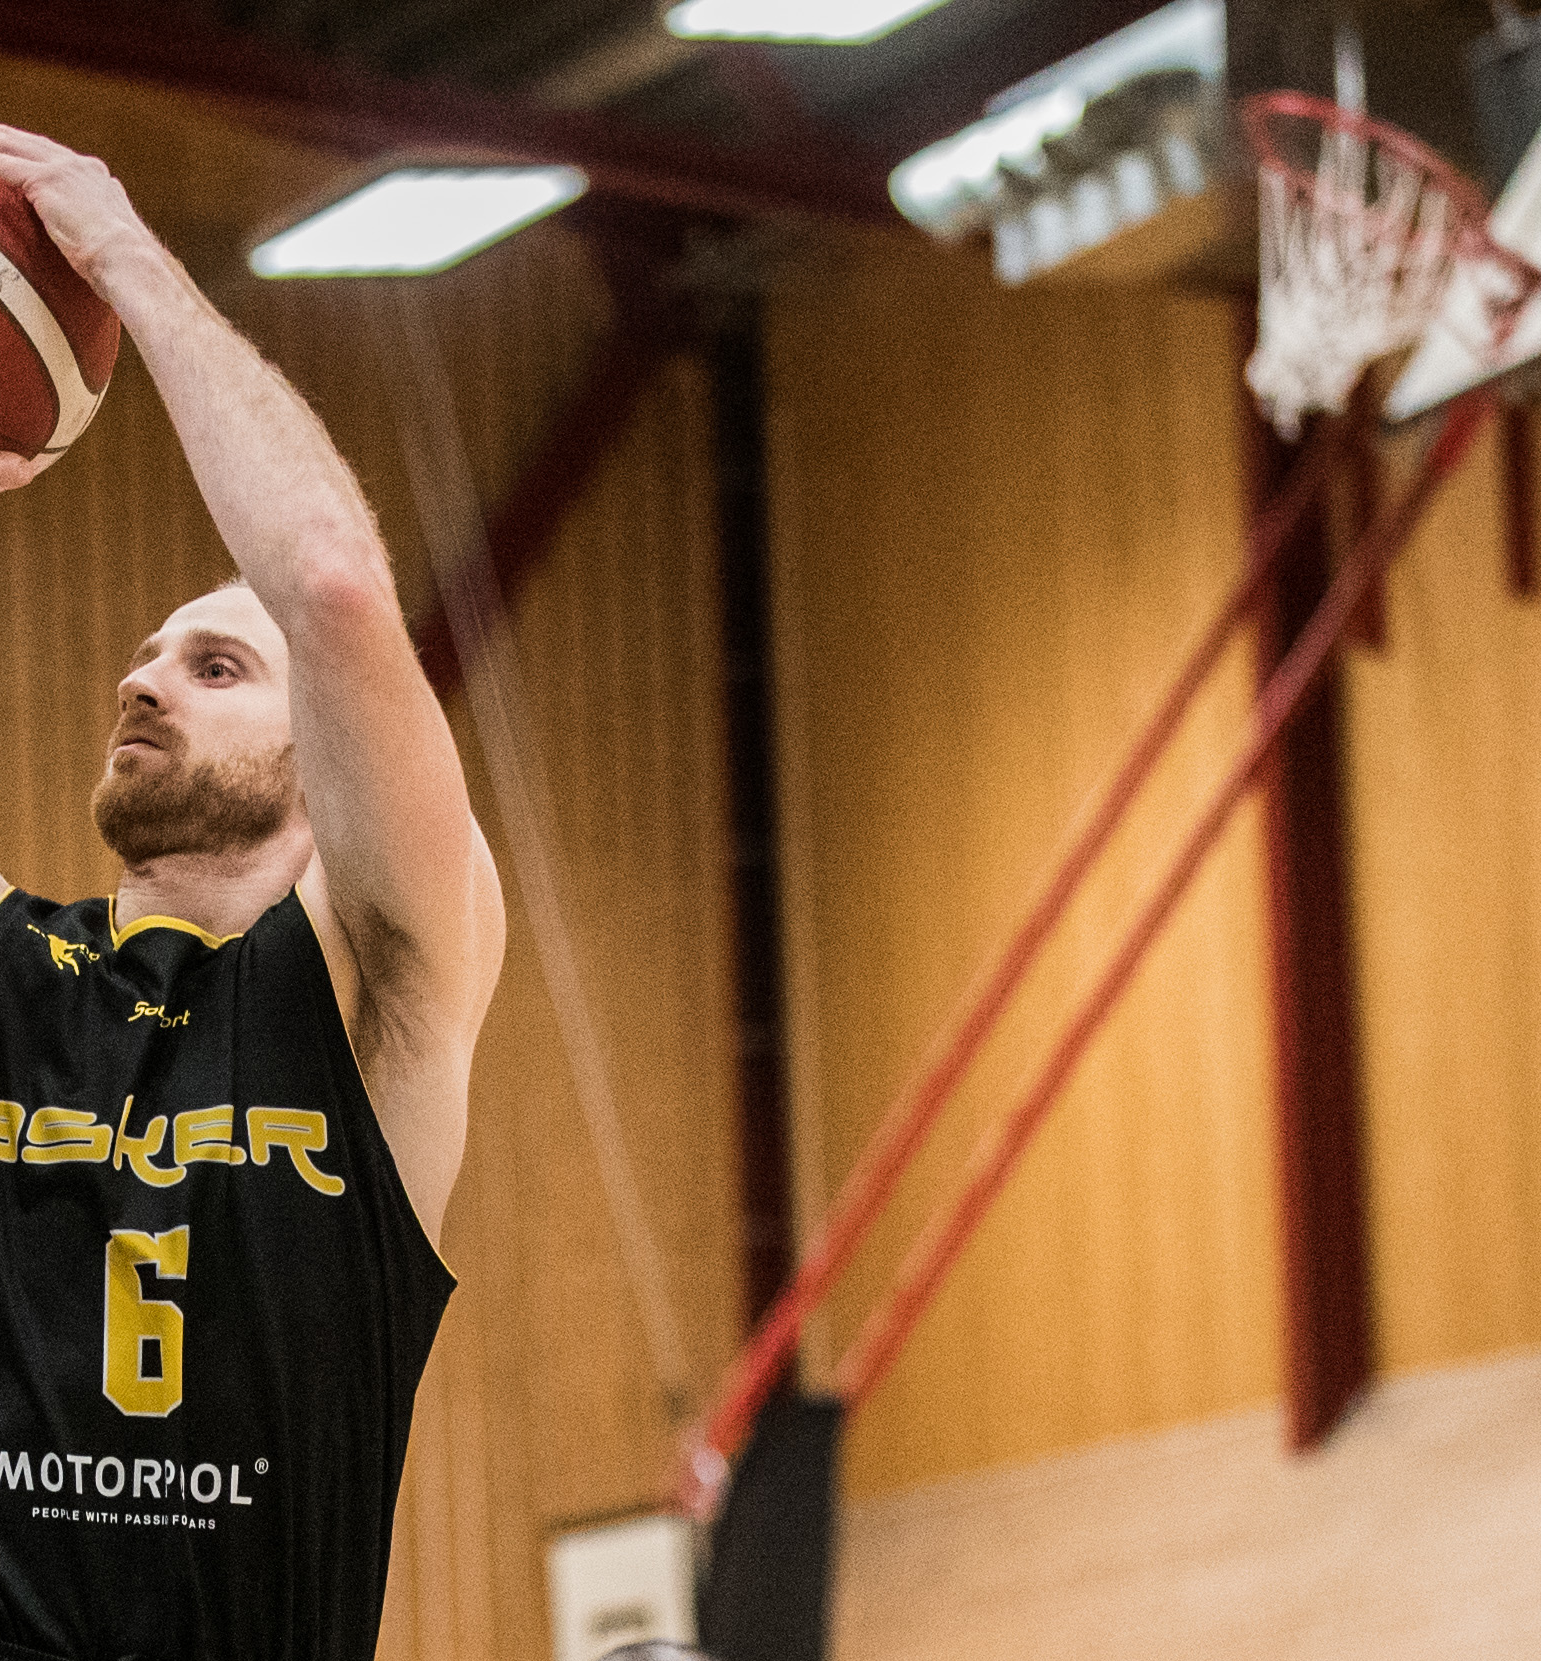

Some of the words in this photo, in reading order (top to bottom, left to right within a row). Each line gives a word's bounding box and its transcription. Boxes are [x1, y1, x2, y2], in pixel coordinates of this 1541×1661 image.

[102, 1224, 190, 1418] 6
[31, 1507, 81, 1521] PEOPLE
[86, 1511, 118, 1524] WITH
